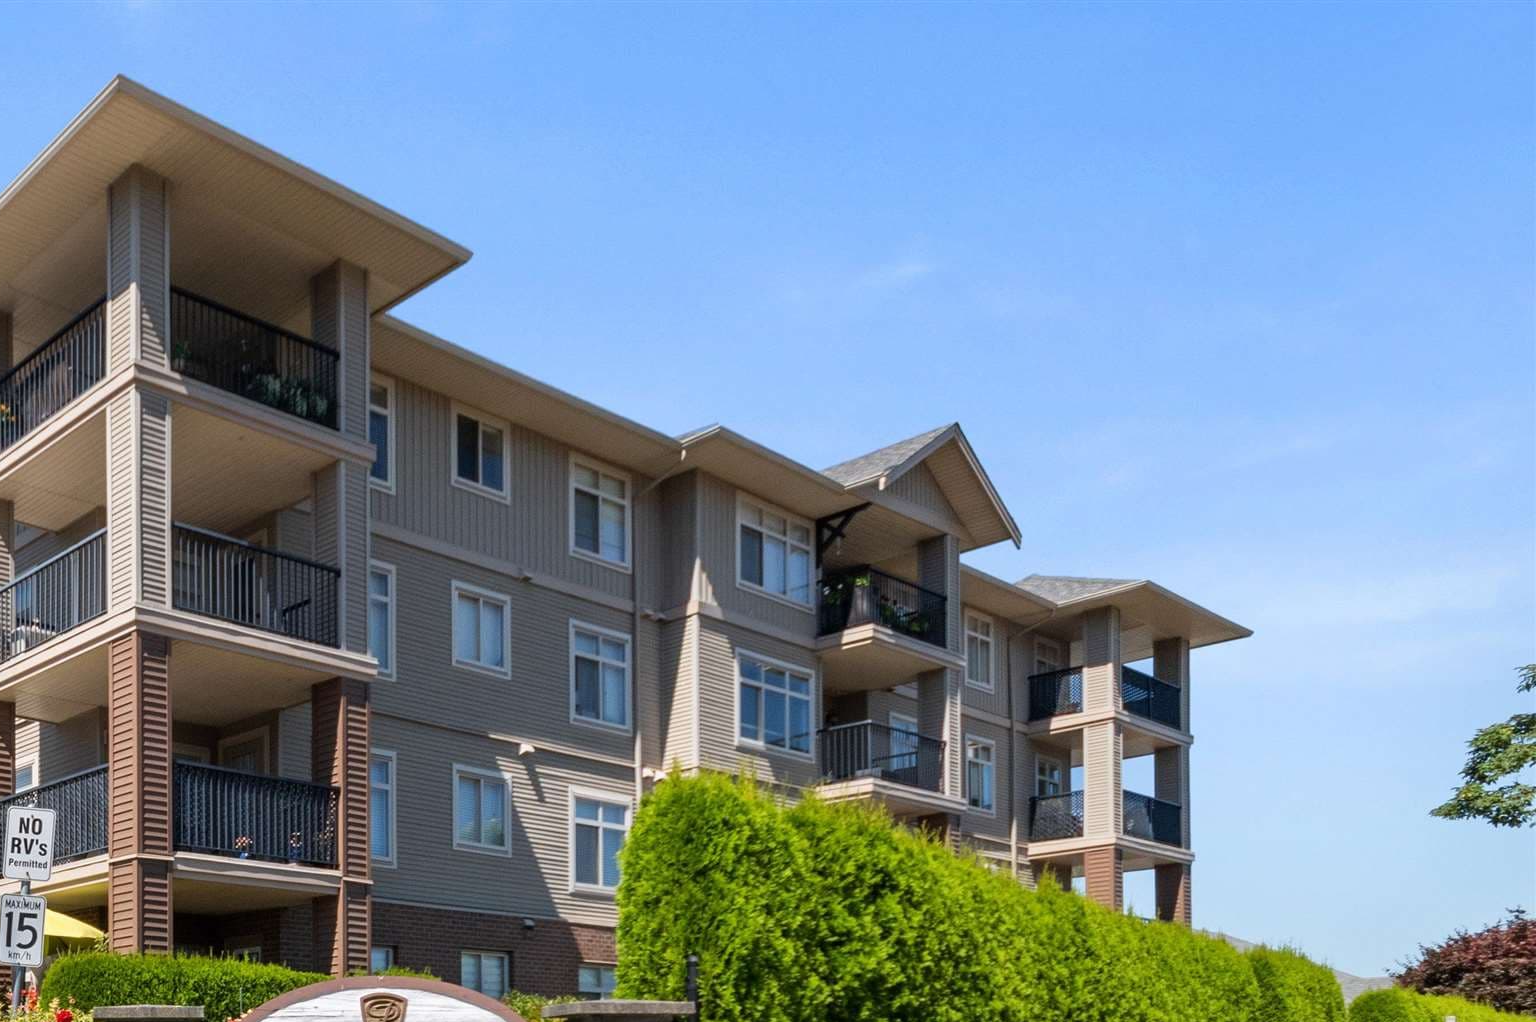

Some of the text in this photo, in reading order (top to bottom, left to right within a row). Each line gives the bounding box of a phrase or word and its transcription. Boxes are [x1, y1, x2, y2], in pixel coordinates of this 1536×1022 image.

[19, 817, 43, 835] NO
[11, 837, 48, 857] RV's
[8, 858, 48, 869] Permitted
[5, 899, 41, 911] MAXIMUM
[5, 912, 38, 950] 15
[8, 951, 31, 961] km/h
